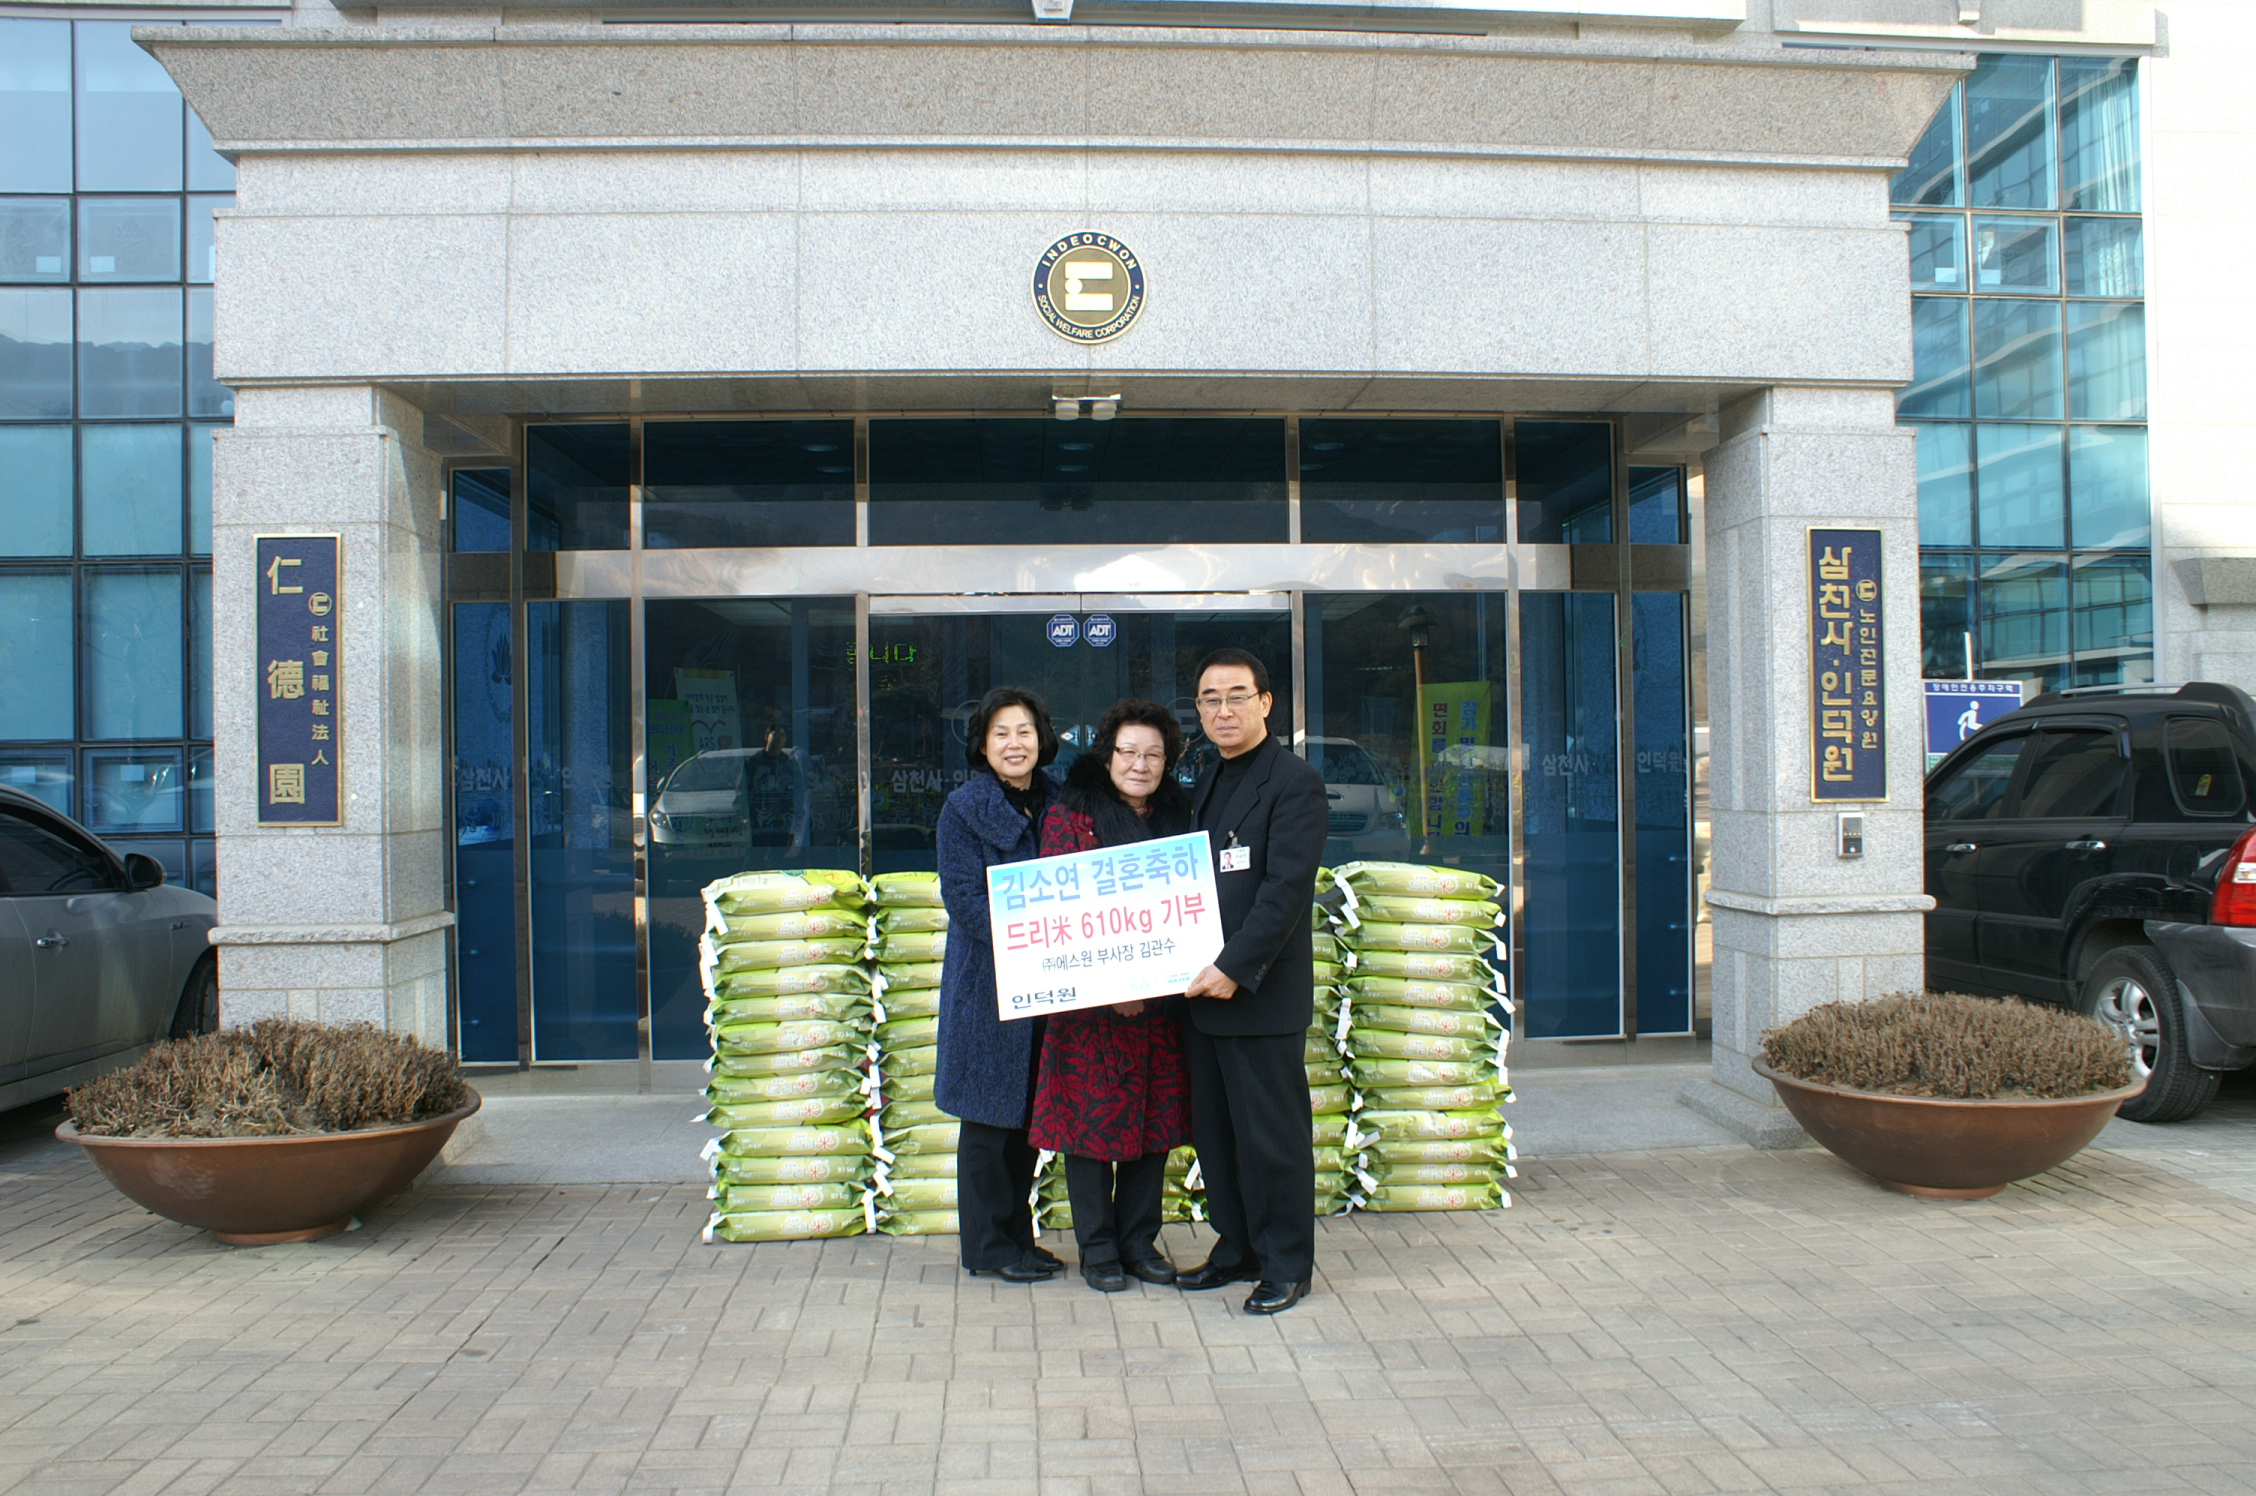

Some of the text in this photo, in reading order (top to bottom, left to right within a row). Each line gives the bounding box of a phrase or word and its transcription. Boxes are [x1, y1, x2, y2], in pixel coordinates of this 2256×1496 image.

[1042, 234, 1137, 270] INDEOCWON
[1038, 294, 1140, 338] SOCIAL WELFARE CORPORATION
[1052, 624, 1074, 636] ADT
[1088, 624, 1110, 636] ADT
[267, 555, 305, 804] 仁德園
[312, 625, 329, 766] 社會福祉法人
[1860, 609, 1878, 749] 노인전문요양원
[1460, 700, 1478, 732] 감기
[1002, 842, 1198, 910] 김소연 결혼축하
[1006, 892, 1206, 950] 드리米 610kg 기부
[1098, 944, 1134, 964] 부사장
[1140, 937, 1176, 958] 김관수
[1011, 986, 1077, 1010] 인덕원
